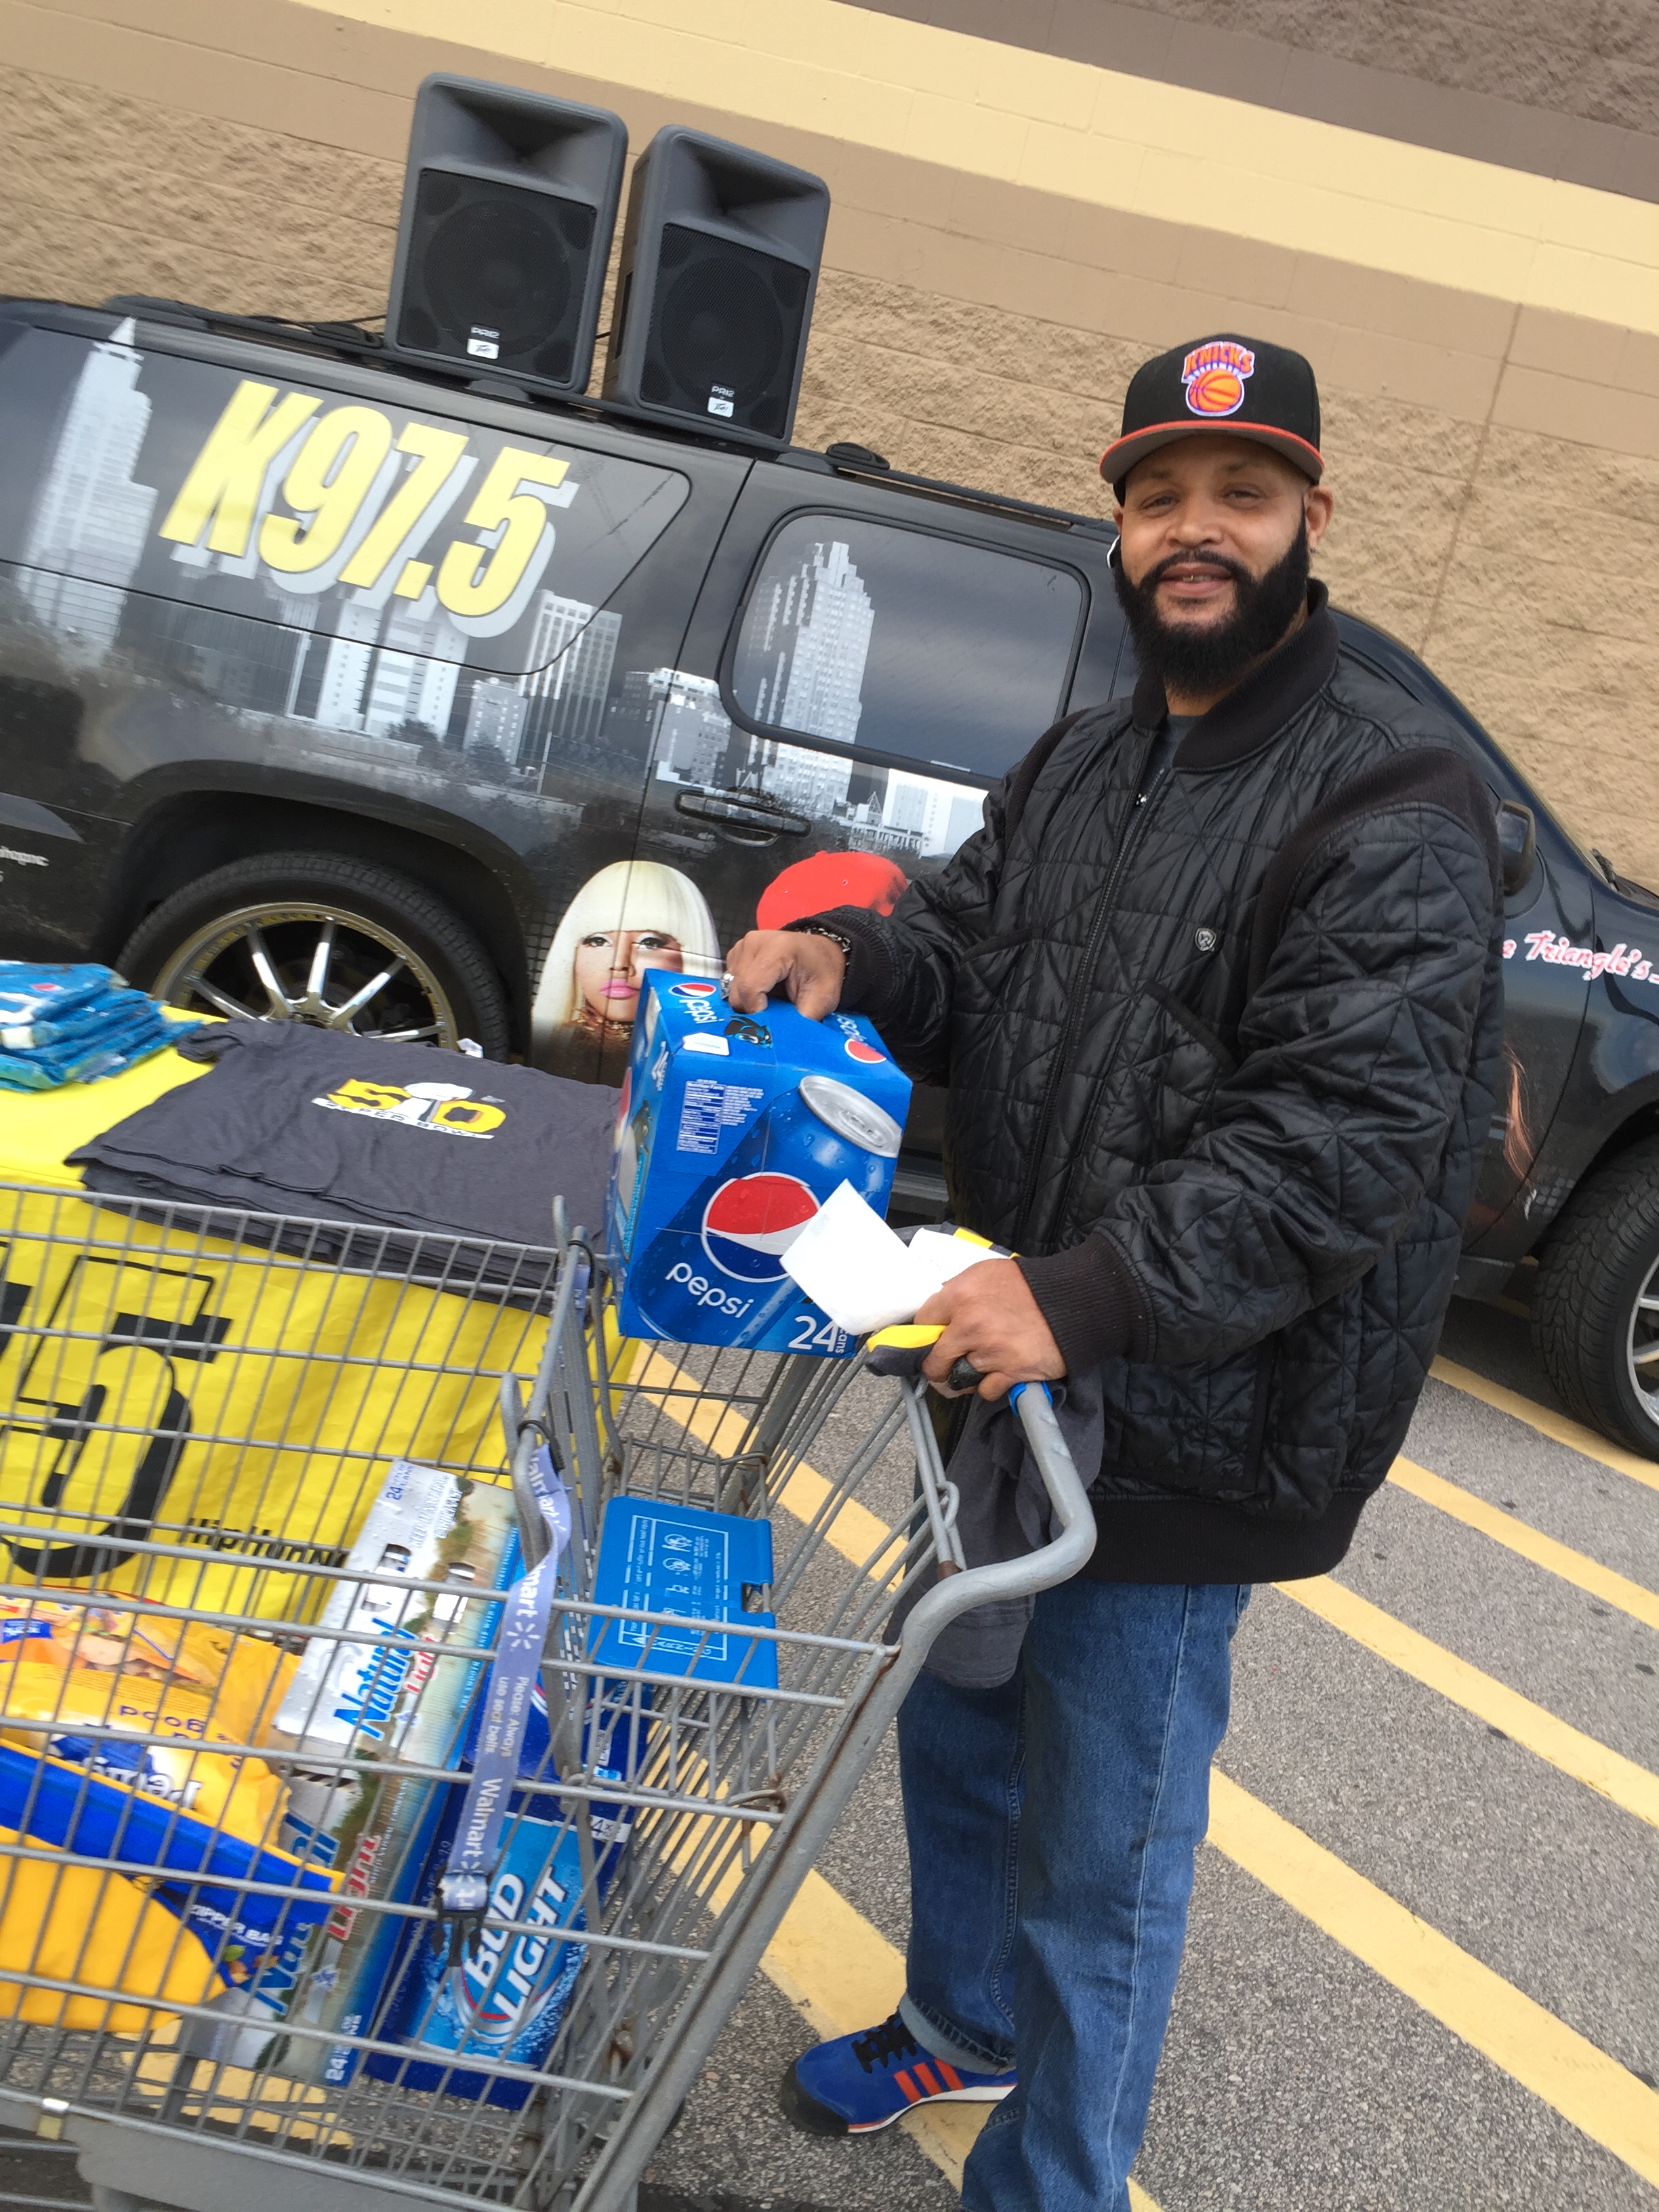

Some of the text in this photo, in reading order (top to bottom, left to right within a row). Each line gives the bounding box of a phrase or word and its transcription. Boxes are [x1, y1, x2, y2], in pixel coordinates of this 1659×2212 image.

[1182, 342, 1254, 381] KNICKS
[159, 380, 576, 623] K97.5
[1523, 930, 1654, 981] Triangle's
[678, 999, 724, 1024] pepsi
[665, 1261, 754, 1319] pepsi
[787, 1315, 839, 1352] 24
[386, 1486, 404, 1501] 24
[496, 1675, 510, 1698] use
[489, 1698, 506, 1723] seat
[499, 1717, 521, 1758] Always
[462, 1777, 504, 1858] Walmart
[463, 1873, 523, 1988] BUD
[493, 1864, 567, 2022] LIGHT
